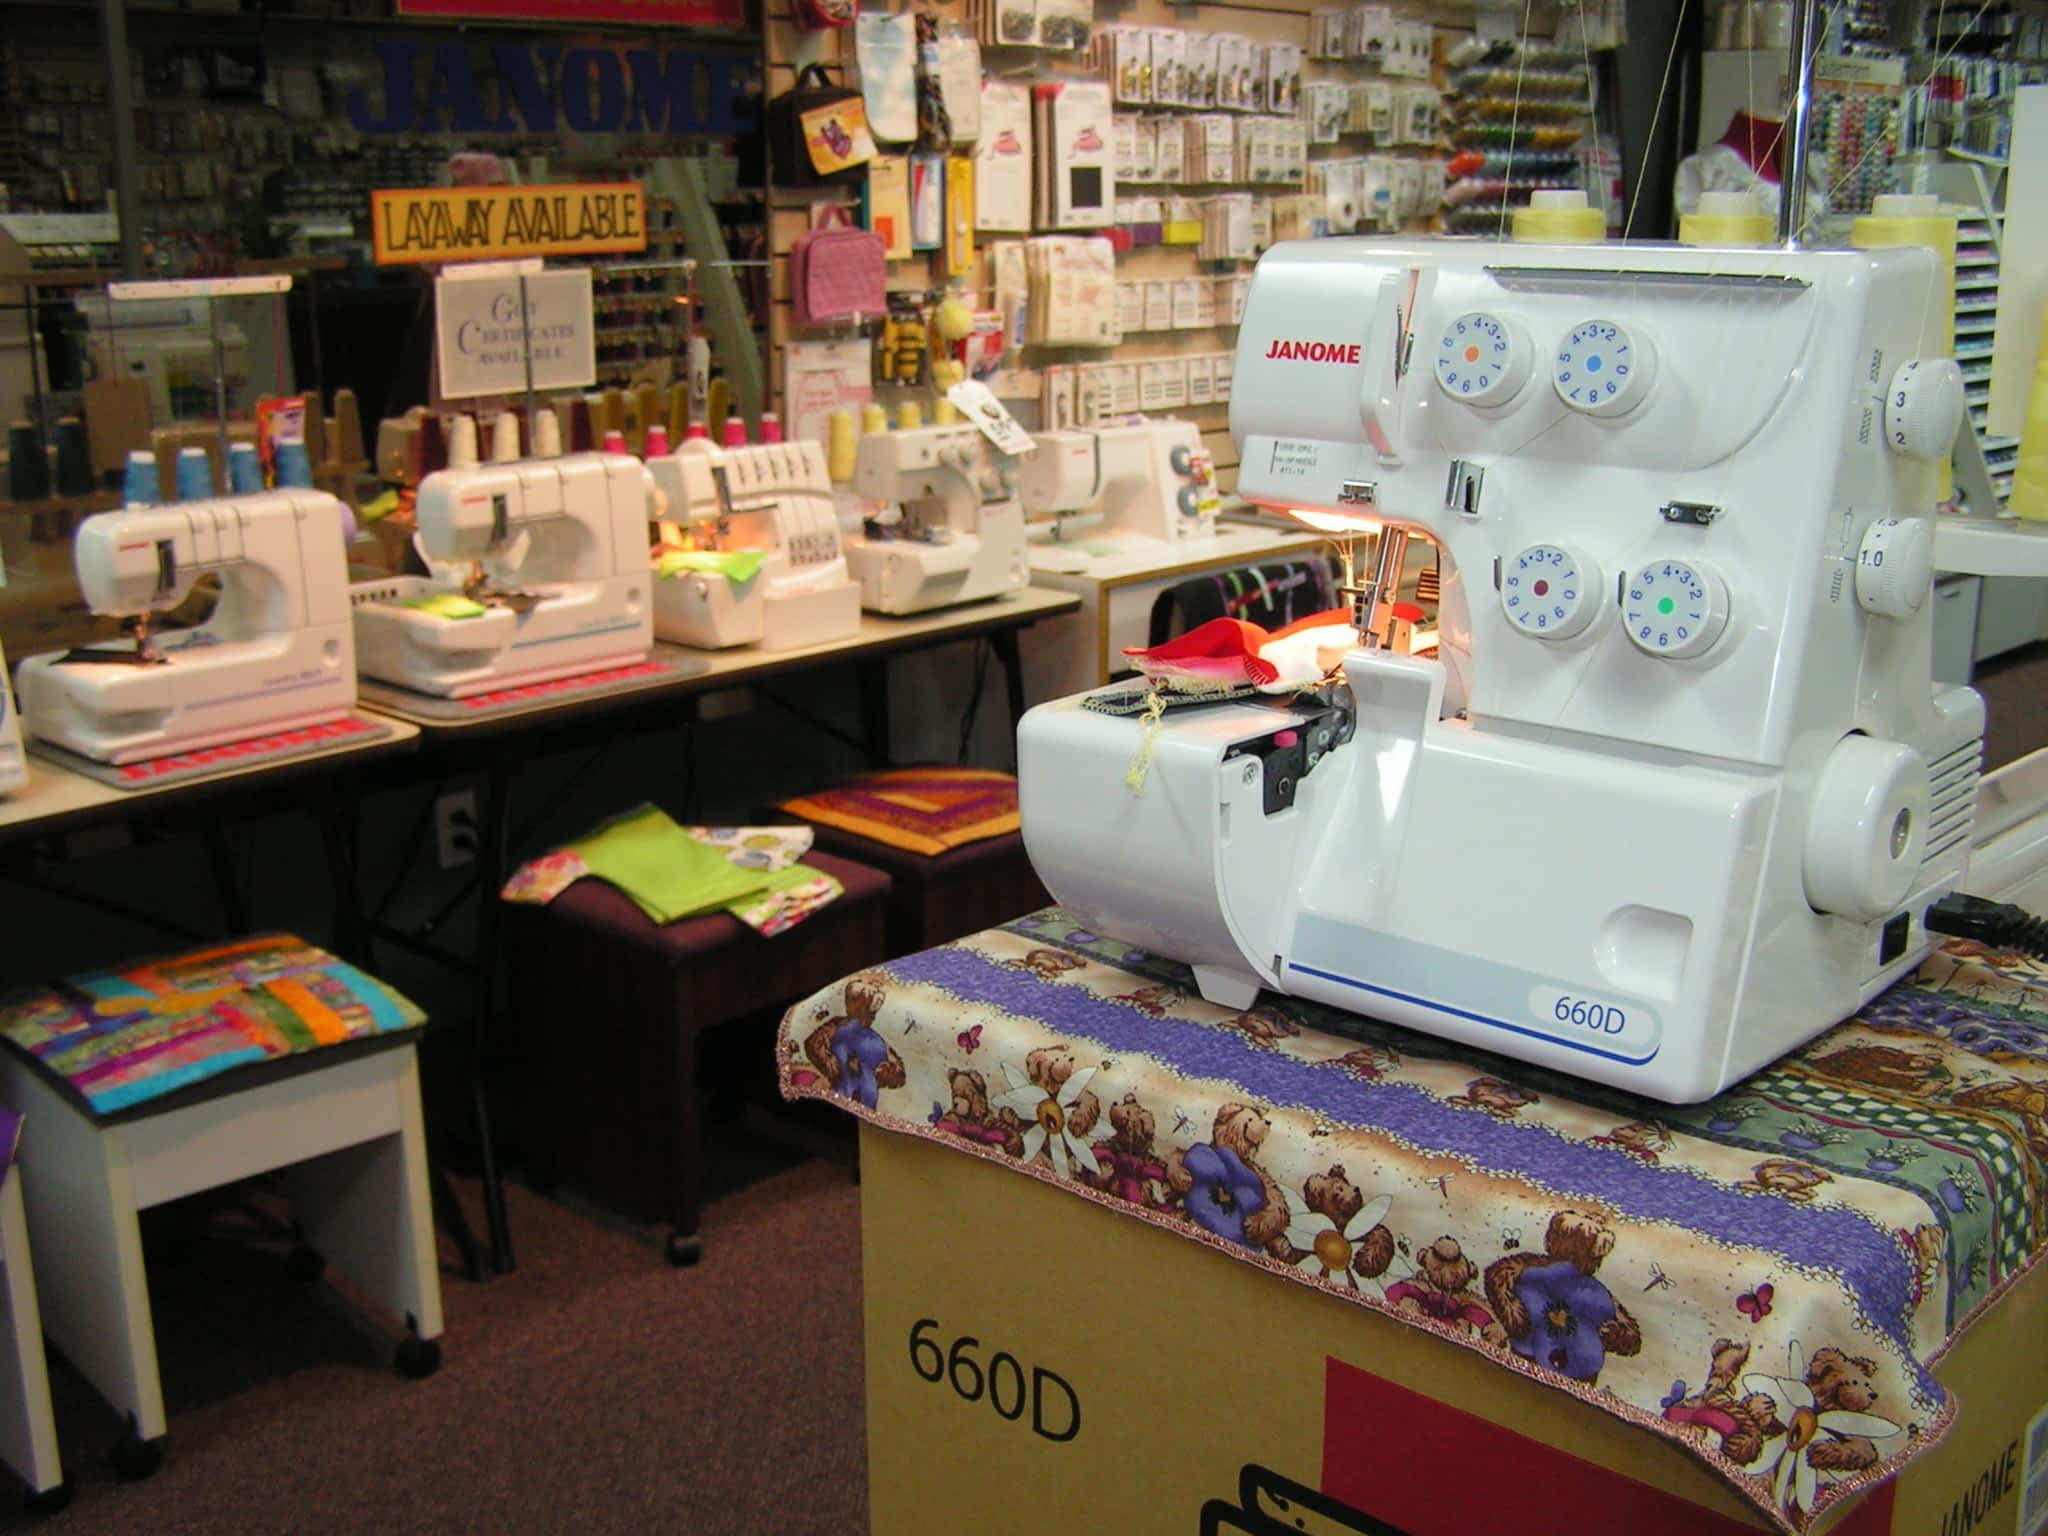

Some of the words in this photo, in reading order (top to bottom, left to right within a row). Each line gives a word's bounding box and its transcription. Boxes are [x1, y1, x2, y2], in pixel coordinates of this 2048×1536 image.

[383, 199, 496, 252] LAYAWAY
[502, 193, 640, 246] AVAILABLE
[1456, 322, 1466, 334] 5
[1473, 317, 1482, 328] 4
[1487, 324, 1499, 336] 3
[1589, 324, 1598, 338] 3
[1605, 328, 1617, 342] 2
[1572, 333, 1581, 344] 4
[1265, 339, 1361, 364] JANOME
[1494, 342, 1506, 352] 2
[1617, 345, 1628, 353] 1
[1439, 359, 1450, 367] 7
[1559, 352, 1571, 362] 5
[1616, 365, 1629, 375] 0
[1446, 372, 1457, 385] 8
[1479, 375, 1488, 387] 0
[1569, 387, 1581, 399] 7
[1589, 389, 1598, 403] 8
[1896, 391, 1905, 408] 3
[1896, 432, 1907, 445] 2
[1535, 549, 1544, 562] 3
[1551, 553, 1563, 567] 2
[1861, 549, 1883, 567] 1.0
[1520, 558, 1528, 569] 4
[1563, 570, 1575, 578] 1
[1663, 565, 1671, 576] 4
[1507, 577, 1519, 587] 5
[1643, 571, 1654, 584] 5
[1680, 571, 1692, 584] 3
[1564, 589, 1576, 600] 0
[1689, 589, 1703, 600] 2
[1519, 611, 1530, 624] 7
[1538, 614, 1546, 627] 8
[1629, 612, 1641, 621] 7
[1640, 626, 1651, 639] 8
[1677, 626, 1688, 639] 0
[1555, 996, 1625, 1034] 660D
[909, 1318, 1081, 1442] 660D
